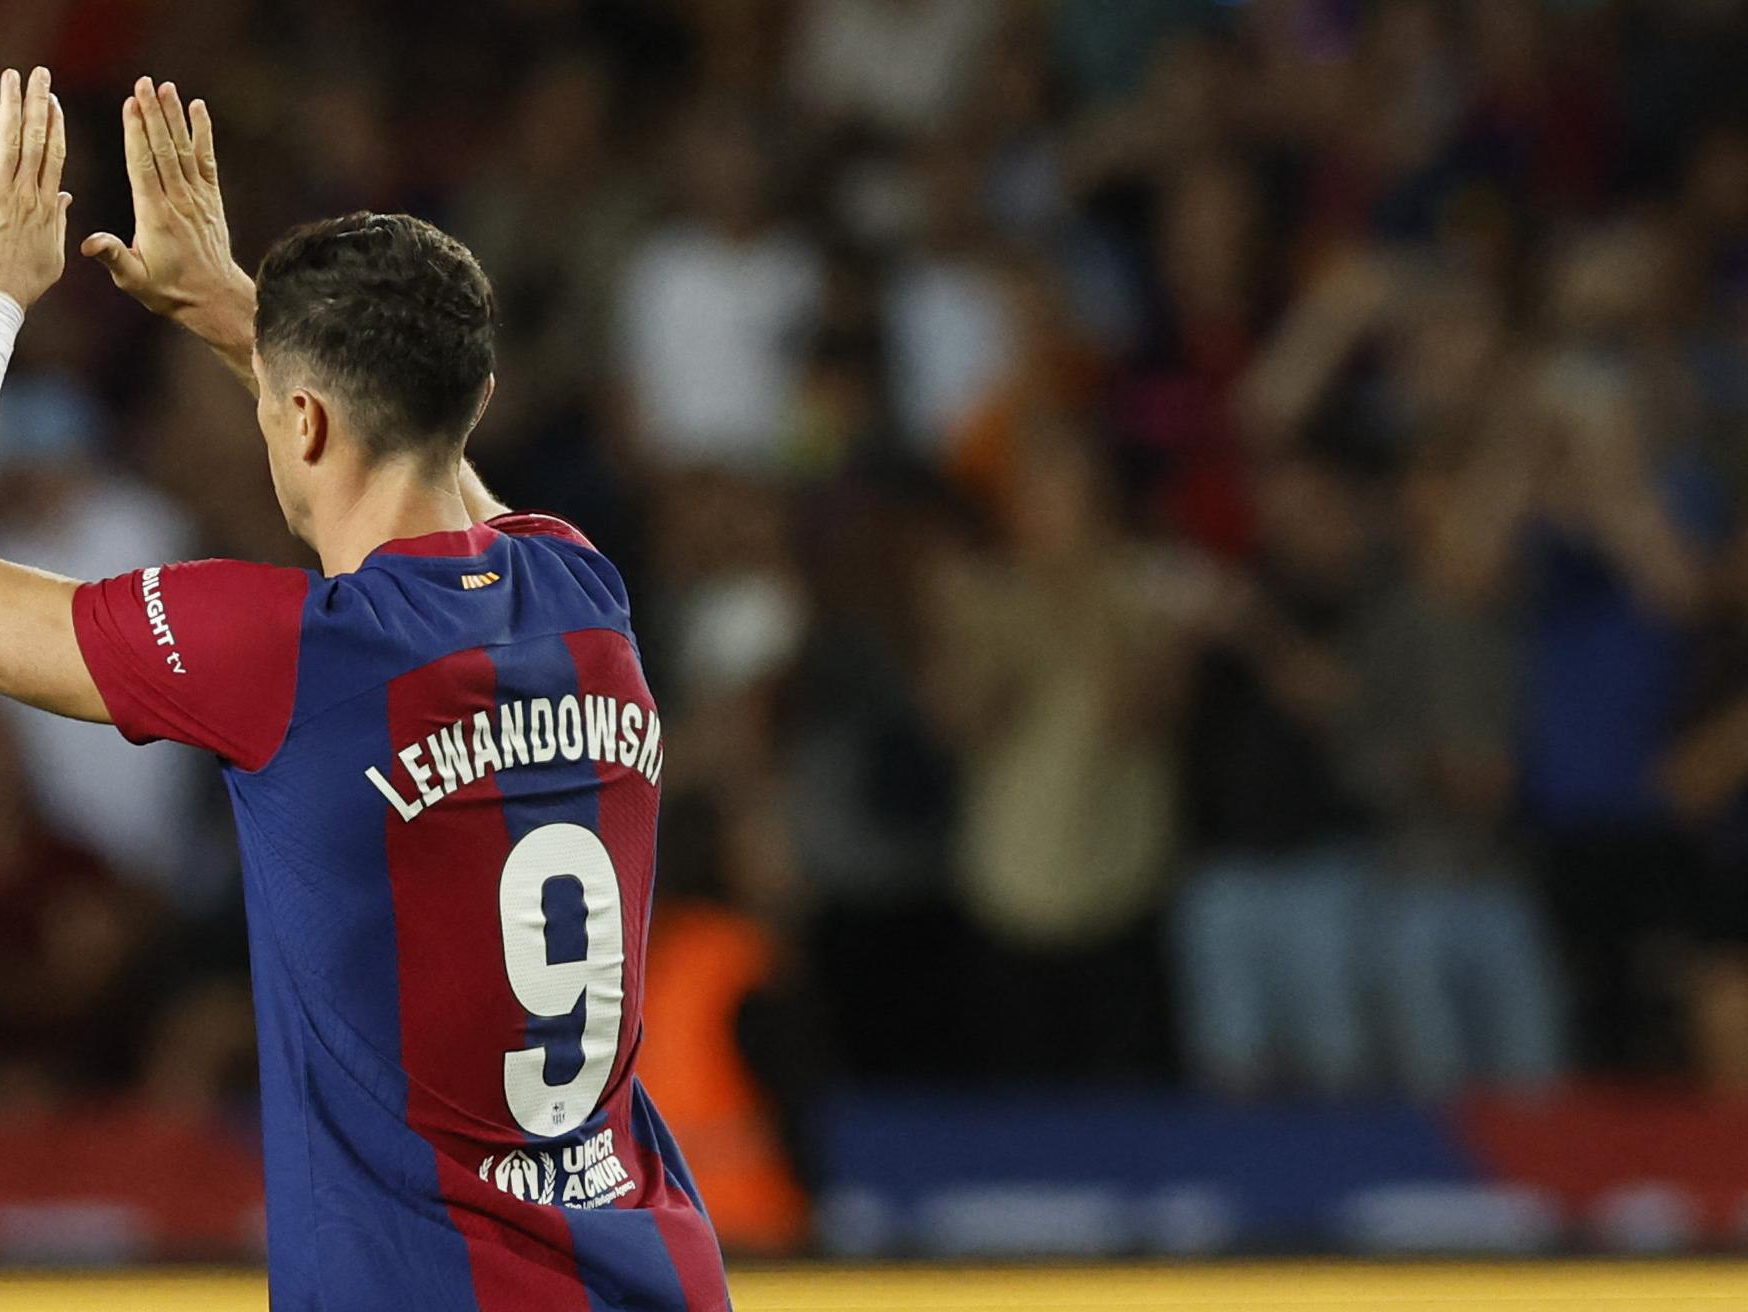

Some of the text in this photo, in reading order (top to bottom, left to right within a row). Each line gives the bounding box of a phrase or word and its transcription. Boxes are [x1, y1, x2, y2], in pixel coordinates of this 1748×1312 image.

[167, 652, 187, 674] tv
[499, 822, 625, 1137] 9
[563, 1128, 614, 1173] UHCR
[562, 1155, 629, 1202] ACNUR
